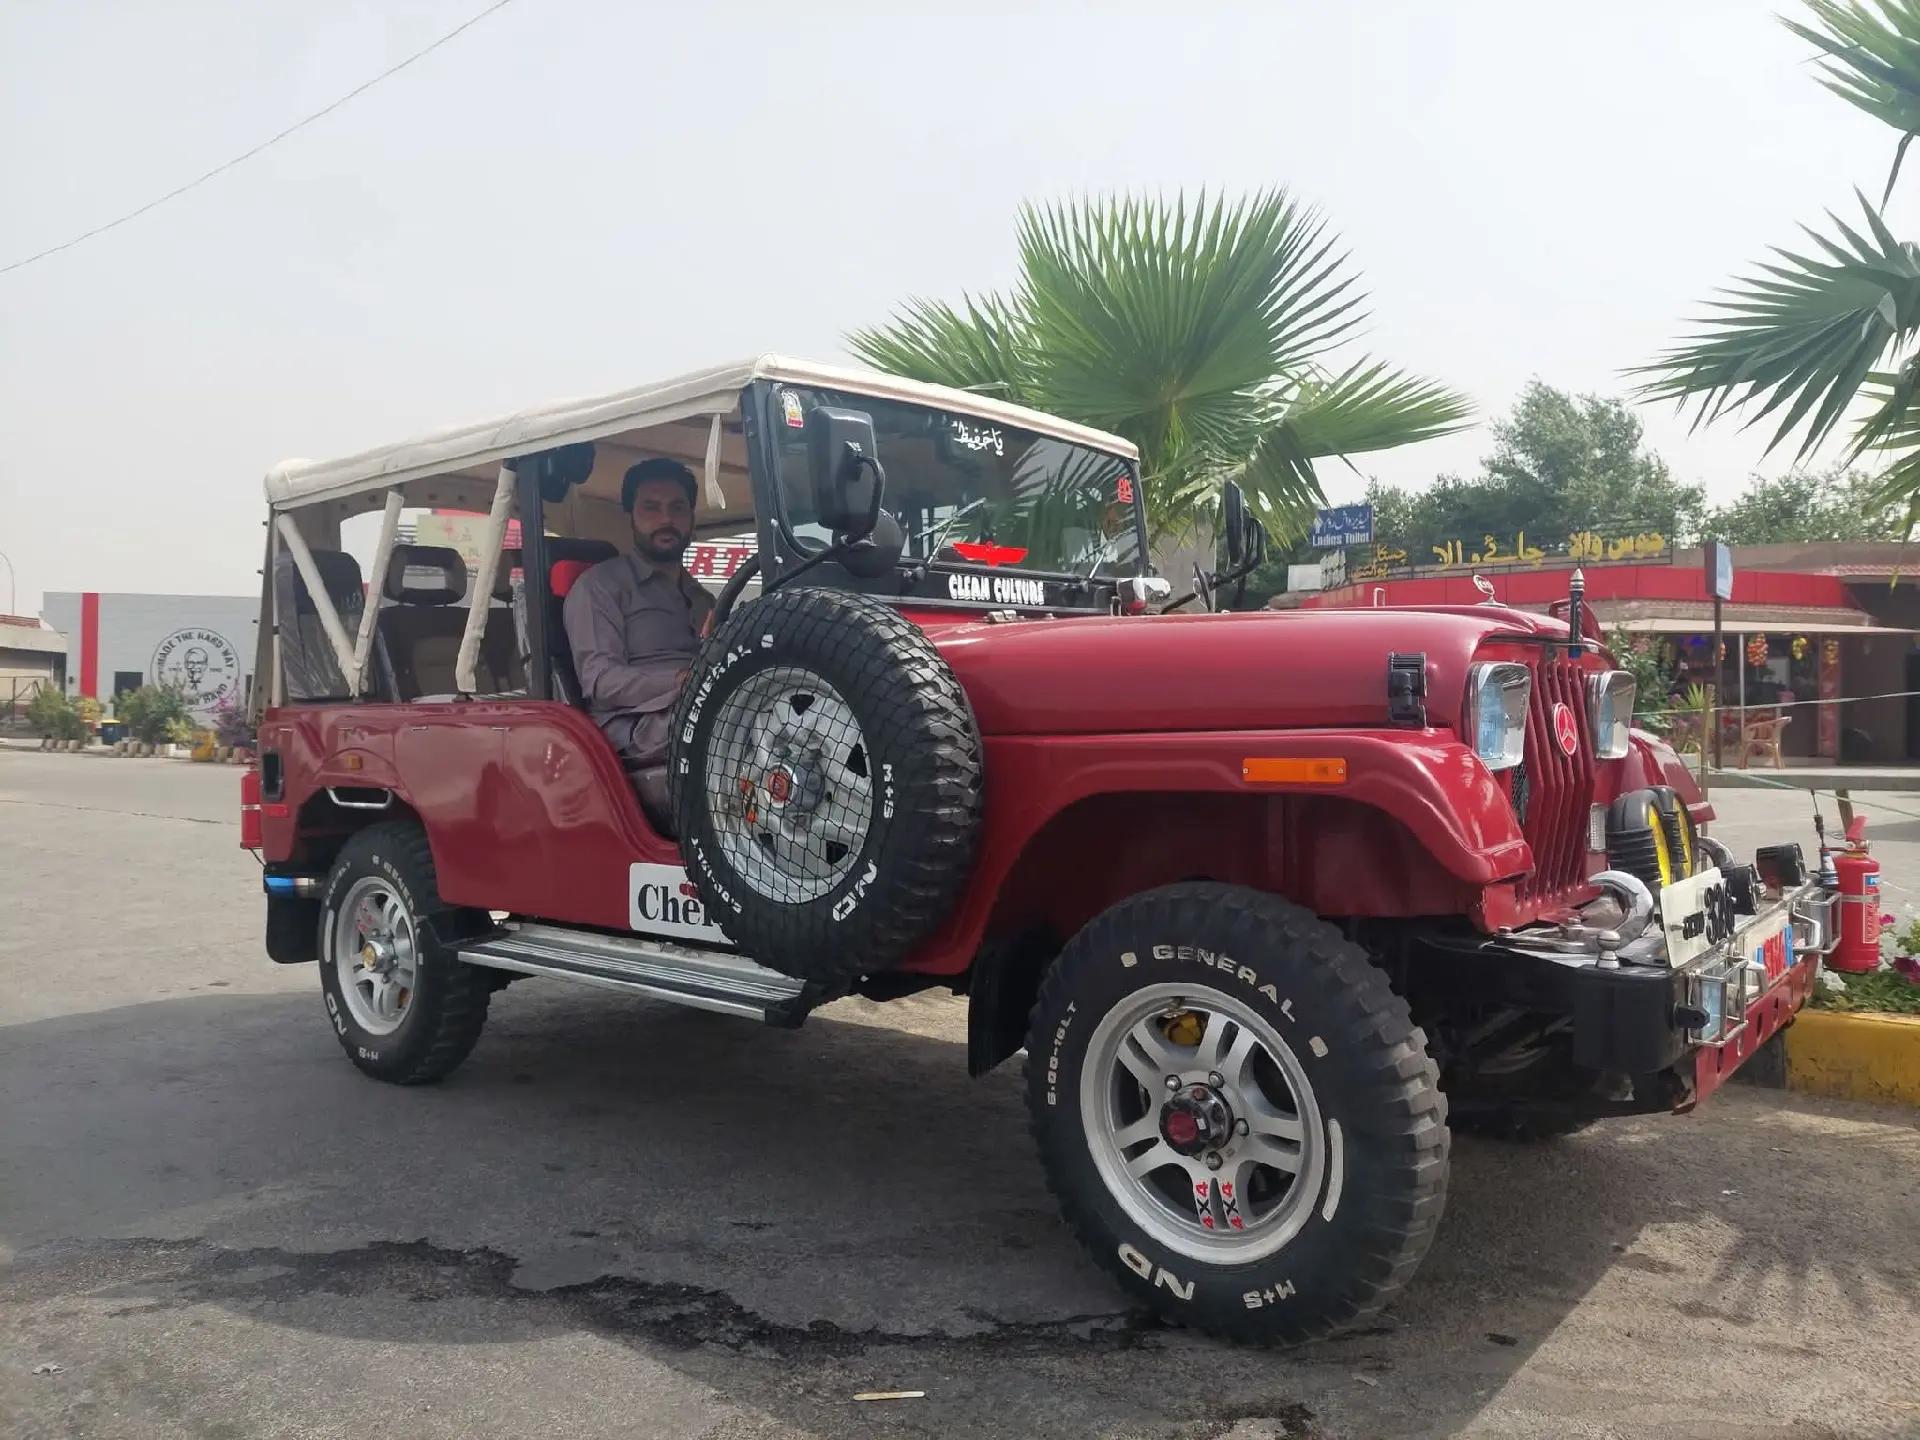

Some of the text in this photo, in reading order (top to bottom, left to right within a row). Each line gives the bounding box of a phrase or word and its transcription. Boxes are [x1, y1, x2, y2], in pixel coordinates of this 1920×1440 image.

[948, 574, 1045, 605] CLEAN CULTURE
[1152, 944, 1296, 1022] GENERAL
